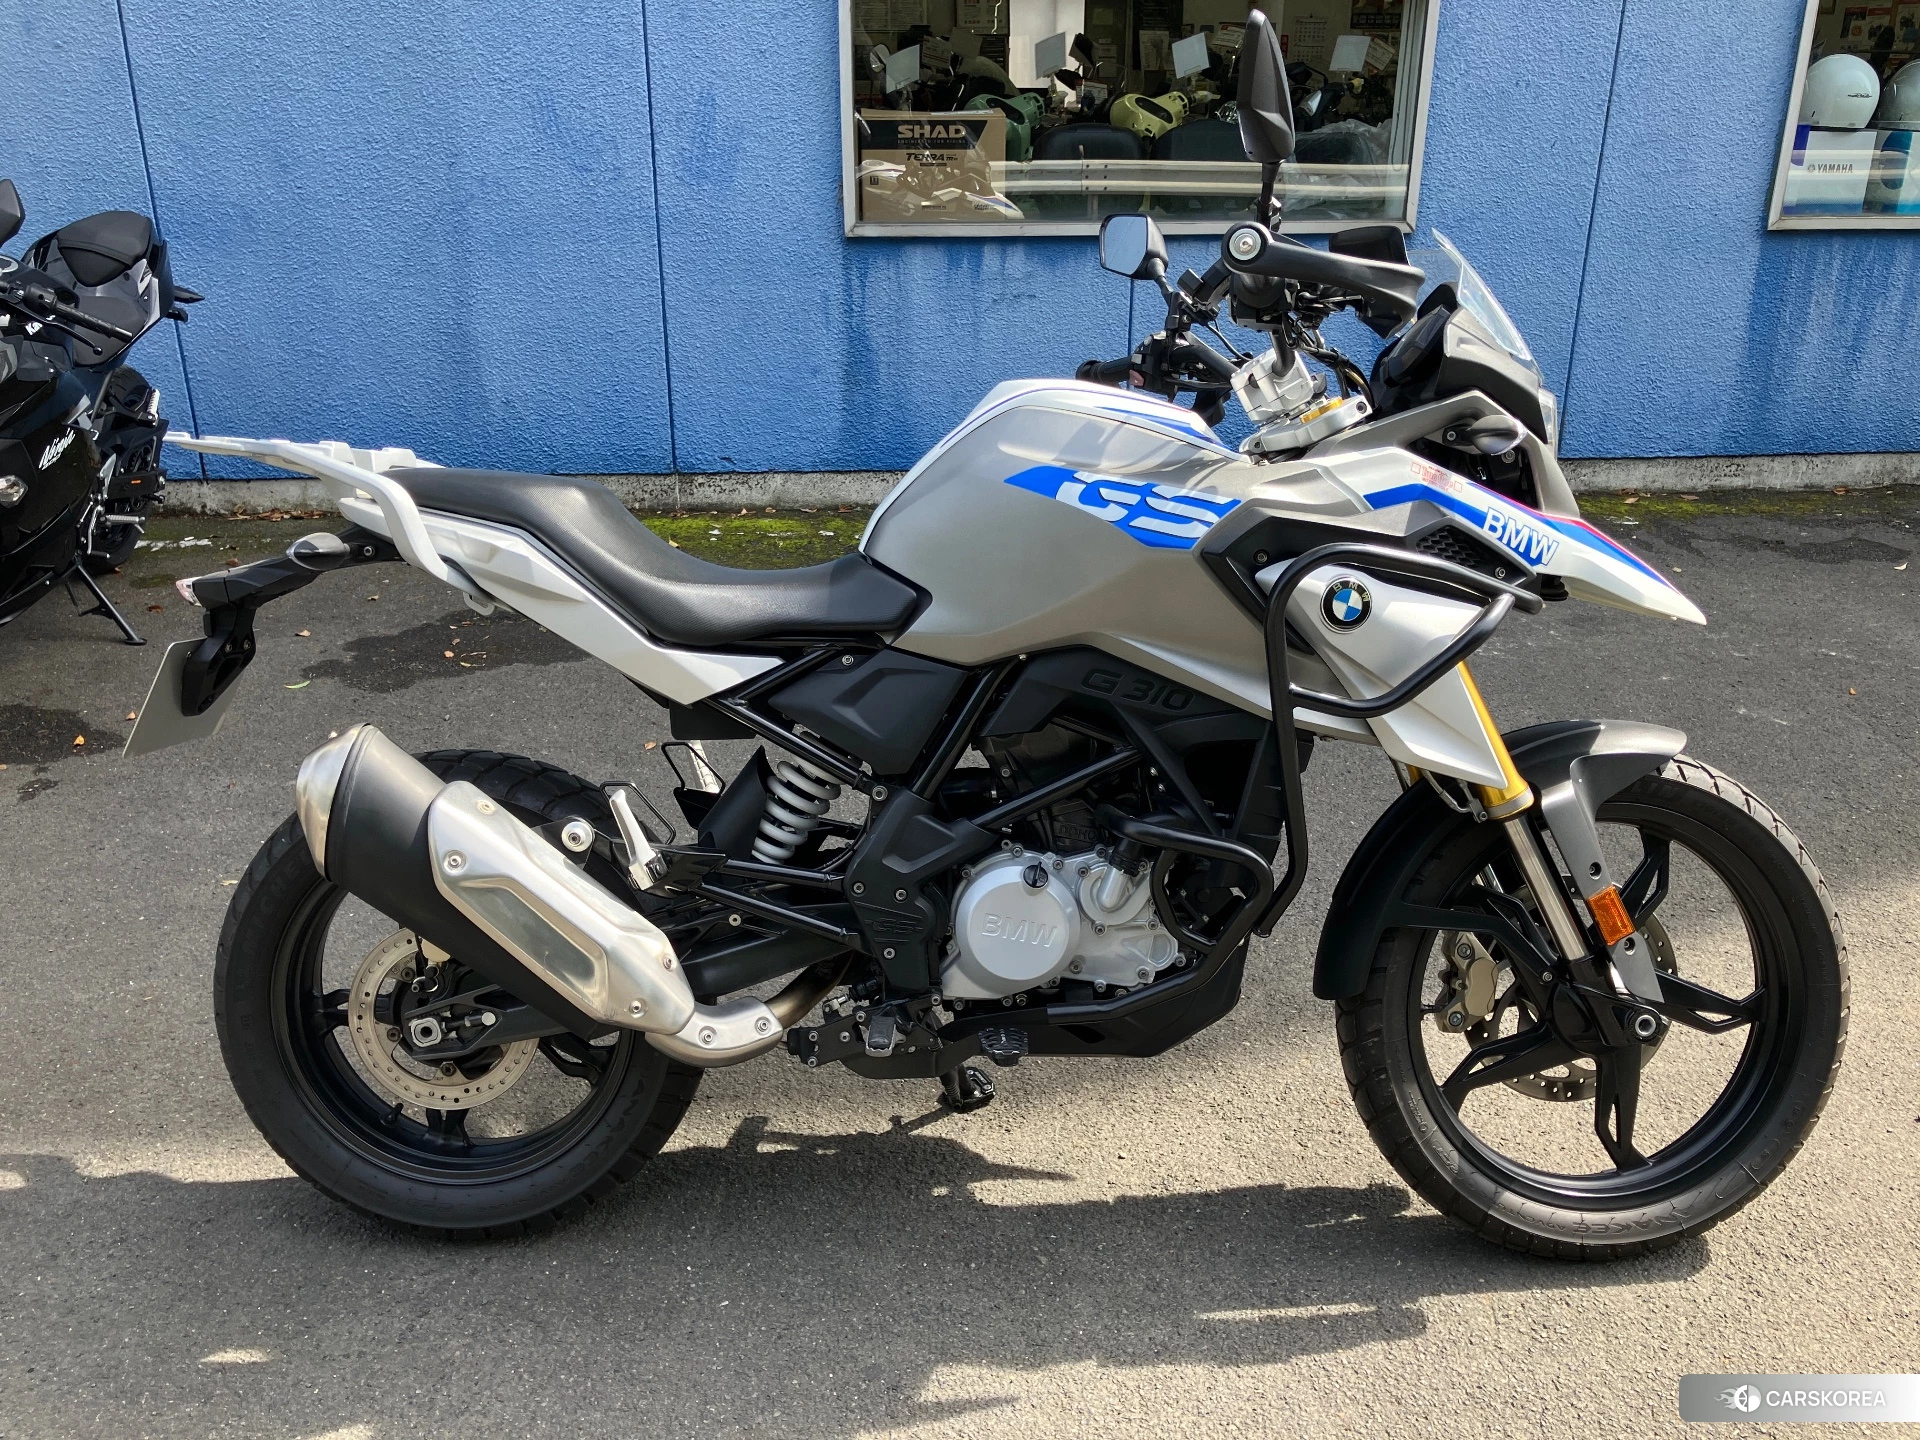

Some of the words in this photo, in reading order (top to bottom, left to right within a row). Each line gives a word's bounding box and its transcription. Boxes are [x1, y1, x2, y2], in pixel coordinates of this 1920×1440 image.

[897, 125, 966, 139] SHAD
[1817, 163, 1853, 174] YAMAHA
[39, 427, 76, 468] Ninja
[1055, 470, 1235, 538] GS
[1482, 506, 1560, 567] BMW
[1332, 581, 1370, 602] BMW
[1081, 669, 1124, 695] G
[1120, 678, 1196, 712] 310
[981, 912, 1059, 948] BMW
